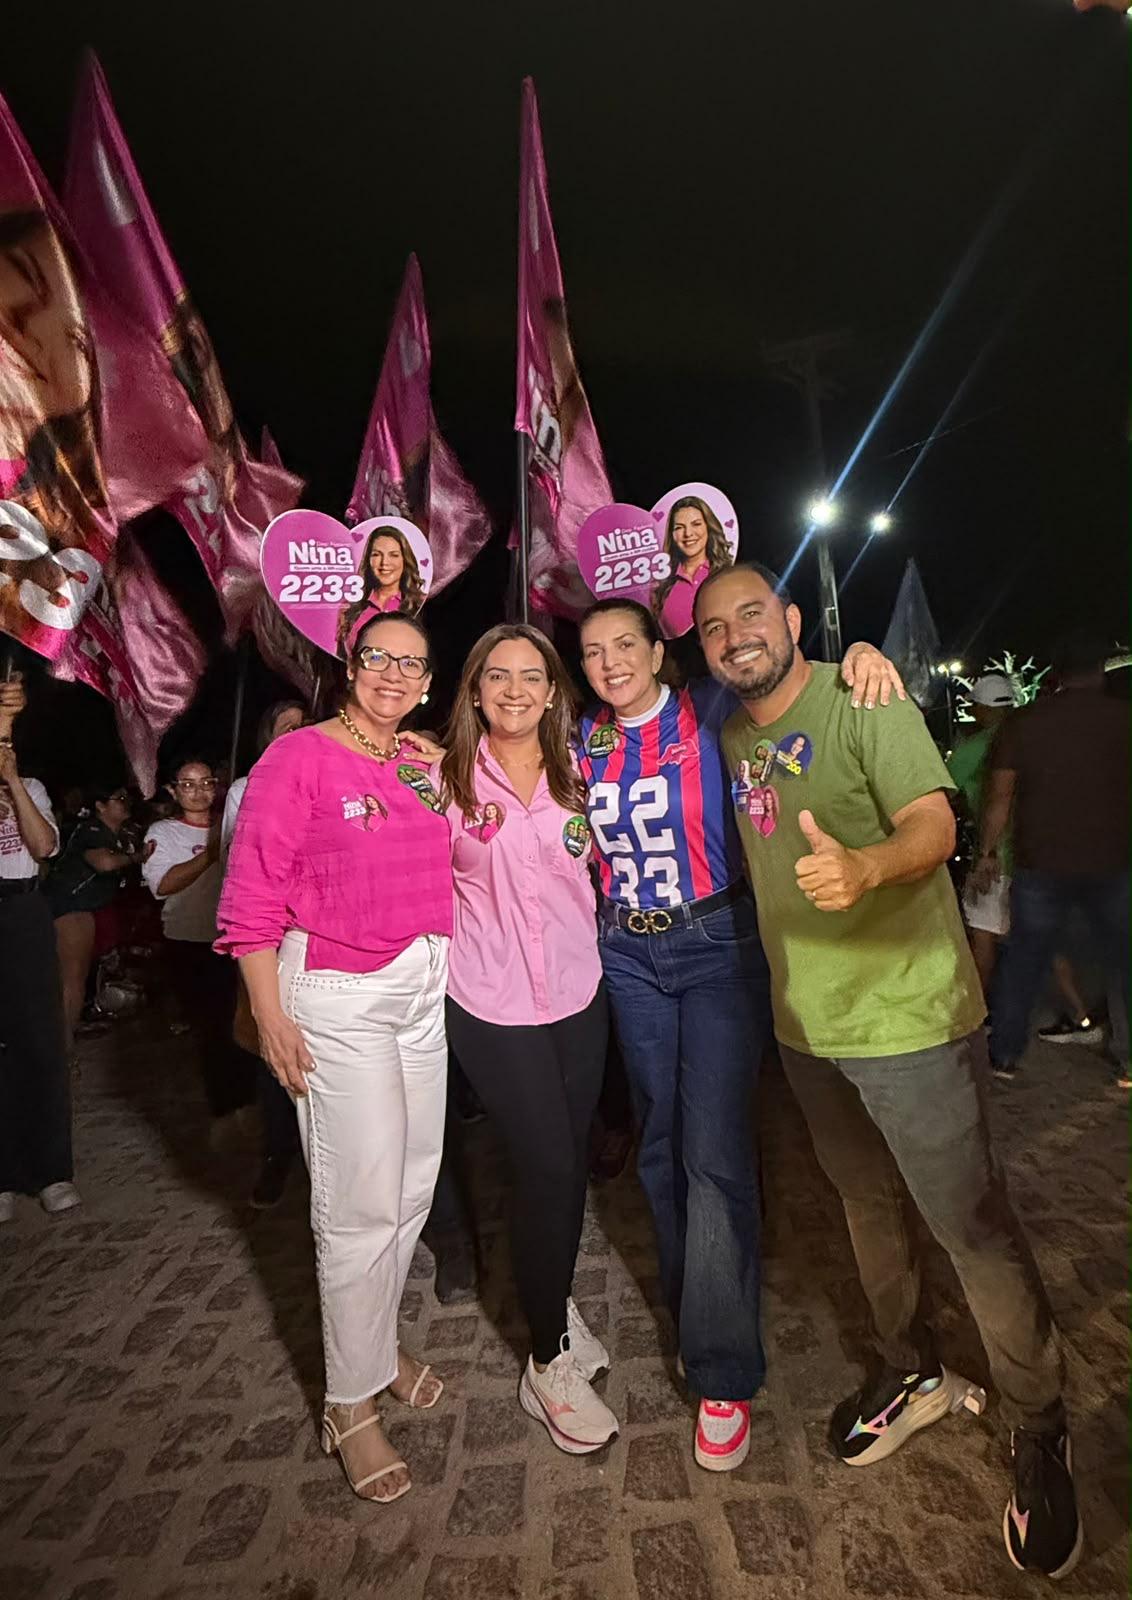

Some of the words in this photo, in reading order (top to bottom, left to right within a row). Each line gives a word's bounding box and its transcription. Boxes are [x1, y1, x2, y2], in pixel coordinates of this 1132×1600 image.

[288, 539, 353, 564] Nina
[597, 528, 658, 555] Nina
[279, 574, 365, 603] 2233
[594, 552, 672, 593] 2233
[588, 775, 676, 855] 22
[611, 856, 683, 910] 33
